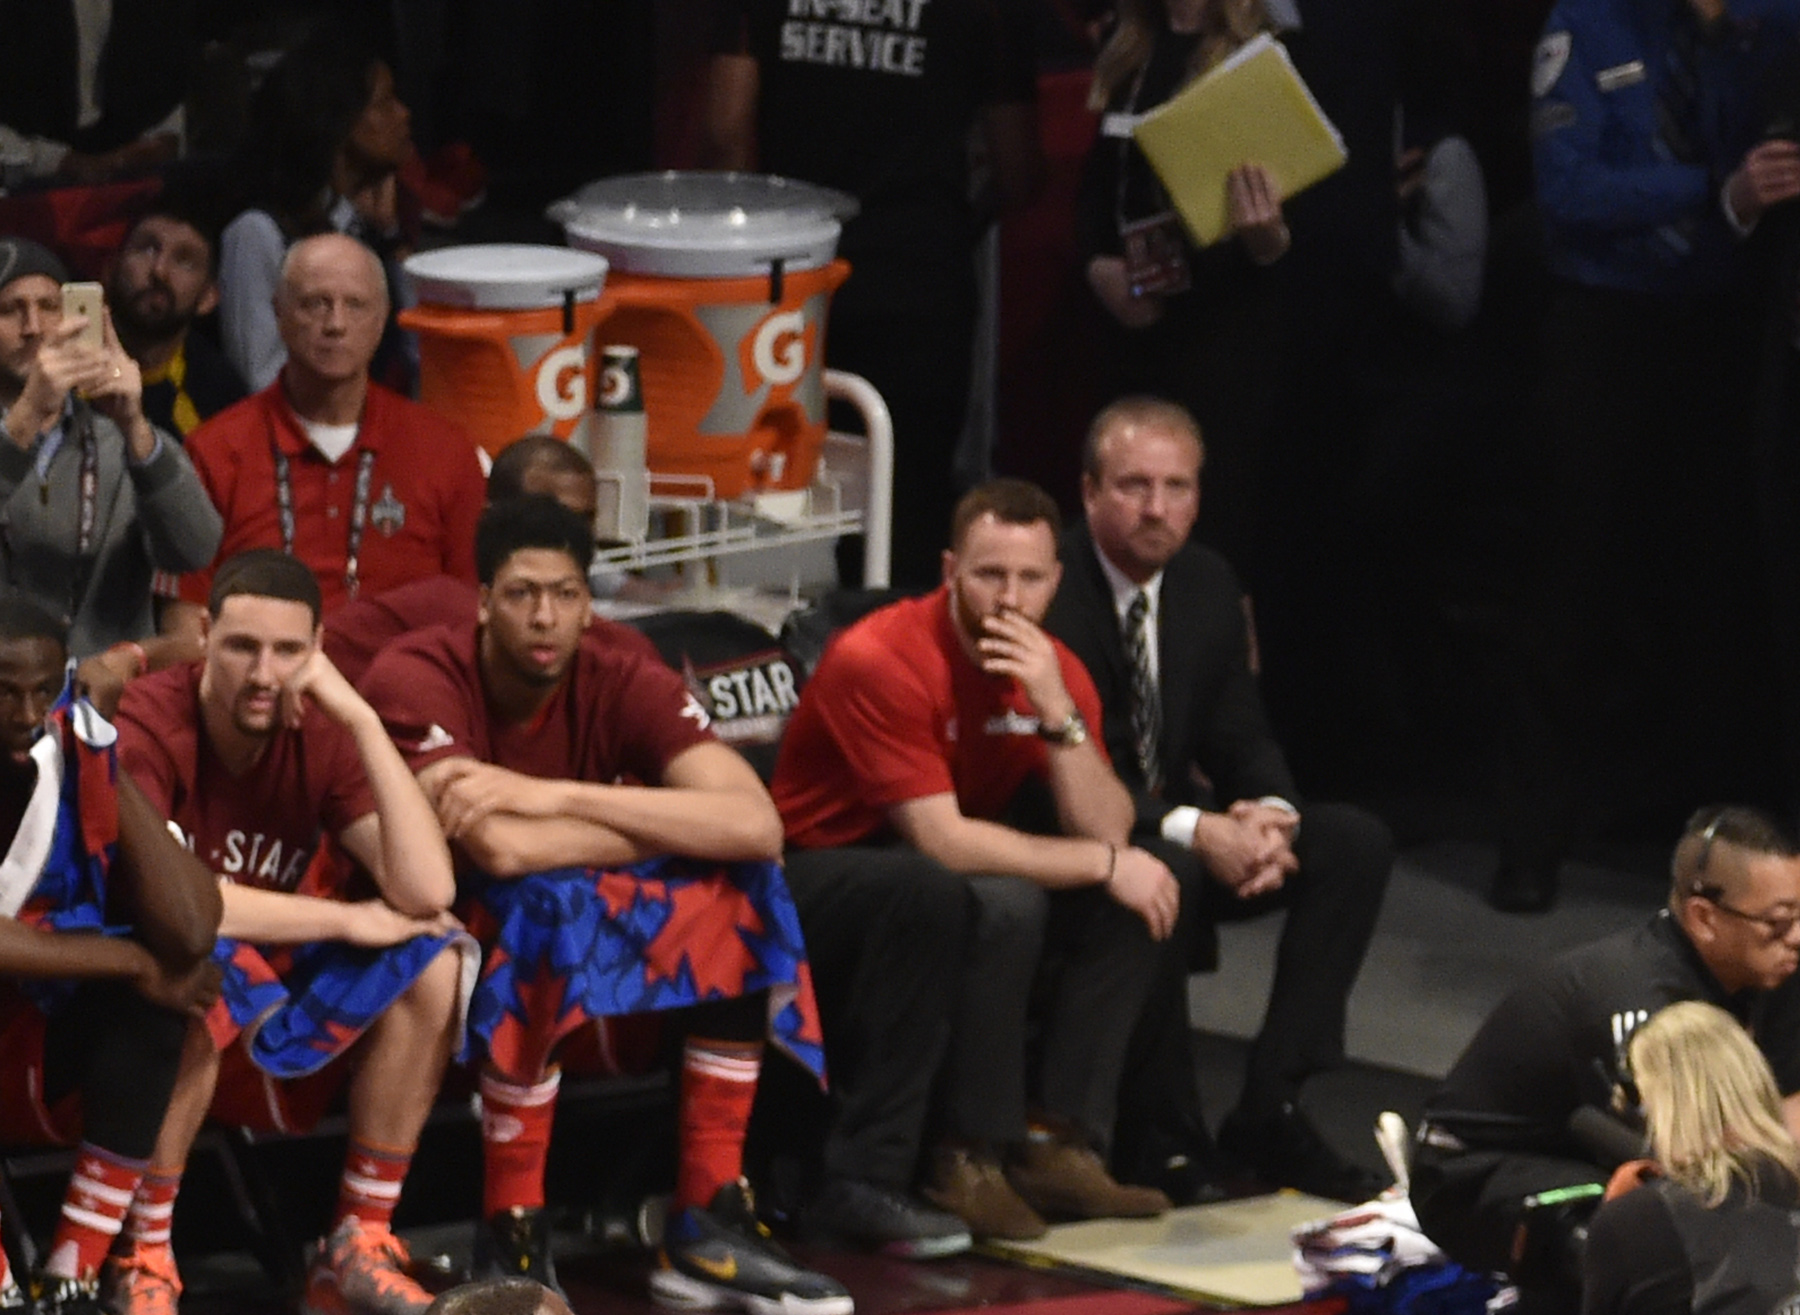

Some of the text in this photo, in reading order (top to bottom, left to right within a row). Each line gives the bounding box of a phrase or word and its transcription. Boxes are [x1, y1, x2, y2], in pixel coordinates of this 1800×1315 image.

[780, 20, 927, 77] SERVICE
[753, 309, 805, 386] G
[535, 345, 587, 420] G
[709, 660, 800, 718] STAR
